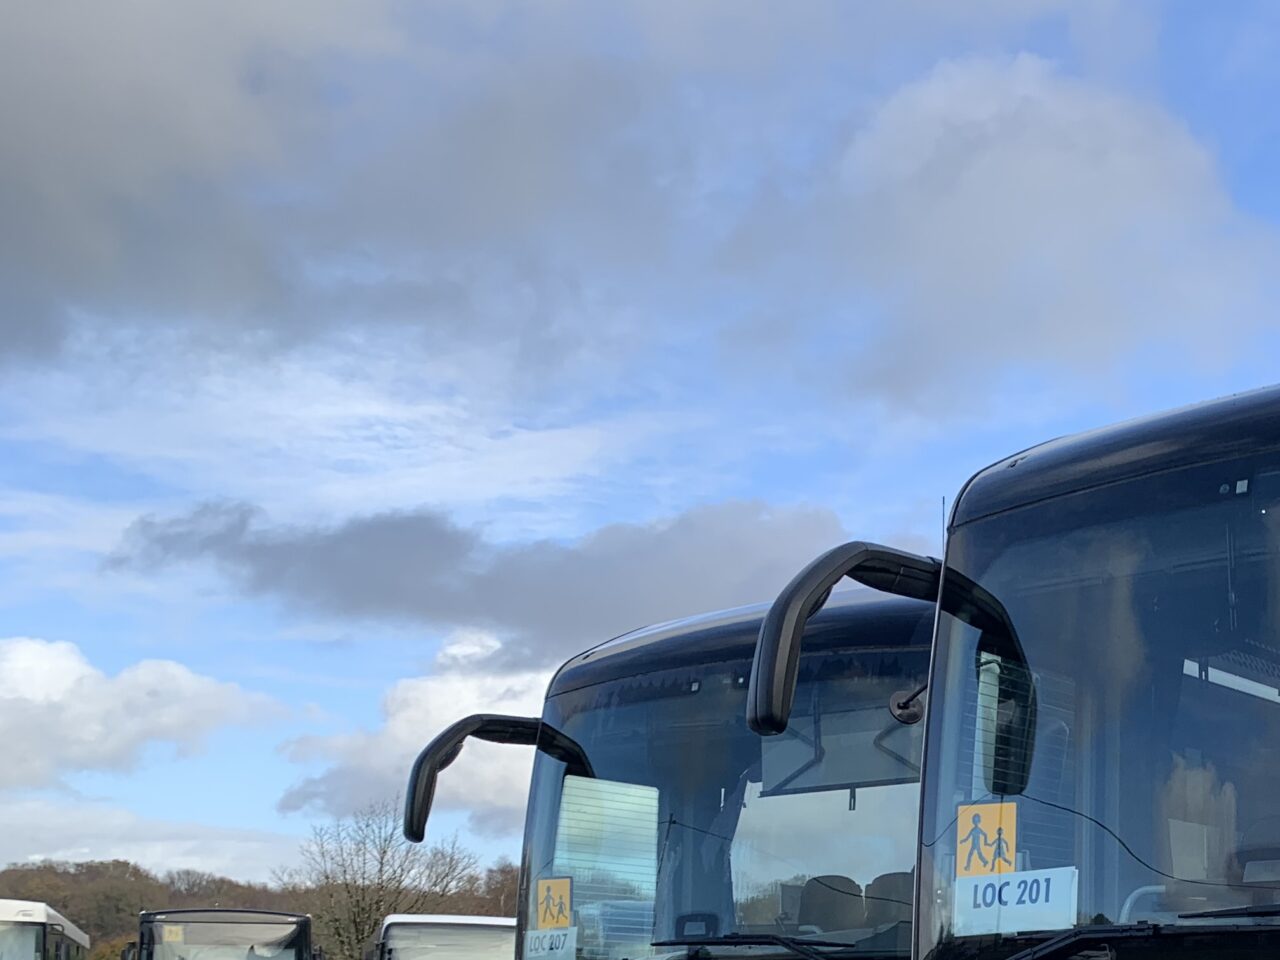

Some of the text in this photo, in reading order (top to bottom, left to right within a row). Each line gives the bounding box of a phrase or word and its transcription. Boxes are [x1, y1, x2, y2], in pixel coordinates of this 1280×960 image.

[972, 877, 1051, 909] LOC 201
[529, 933, 568, 953] LOC 207
